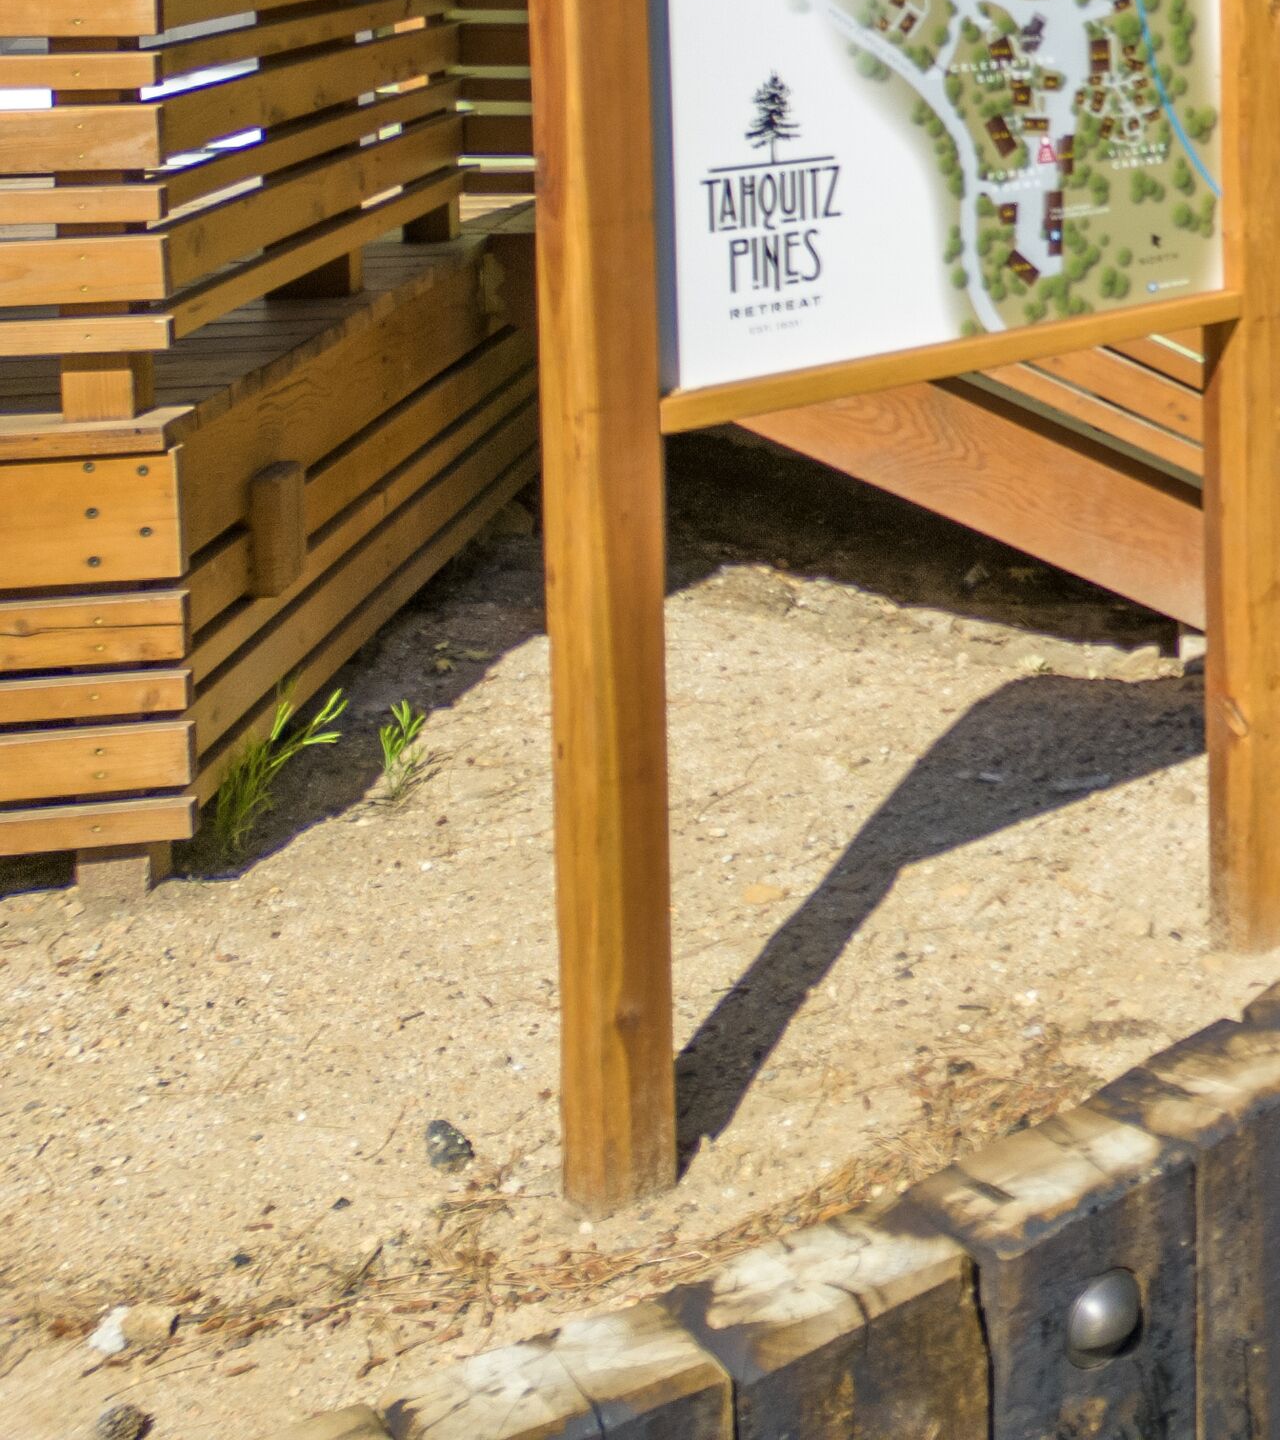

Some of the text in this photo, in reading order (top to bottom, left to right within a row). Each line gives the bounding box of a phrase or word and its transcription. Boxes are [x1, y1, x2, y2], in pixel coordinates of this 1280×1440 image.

[700, 165, 842, 233] TAHQUITZ
[729, 229, 821, 293] PINES
[730, 295, 822, 320] RETREAT
